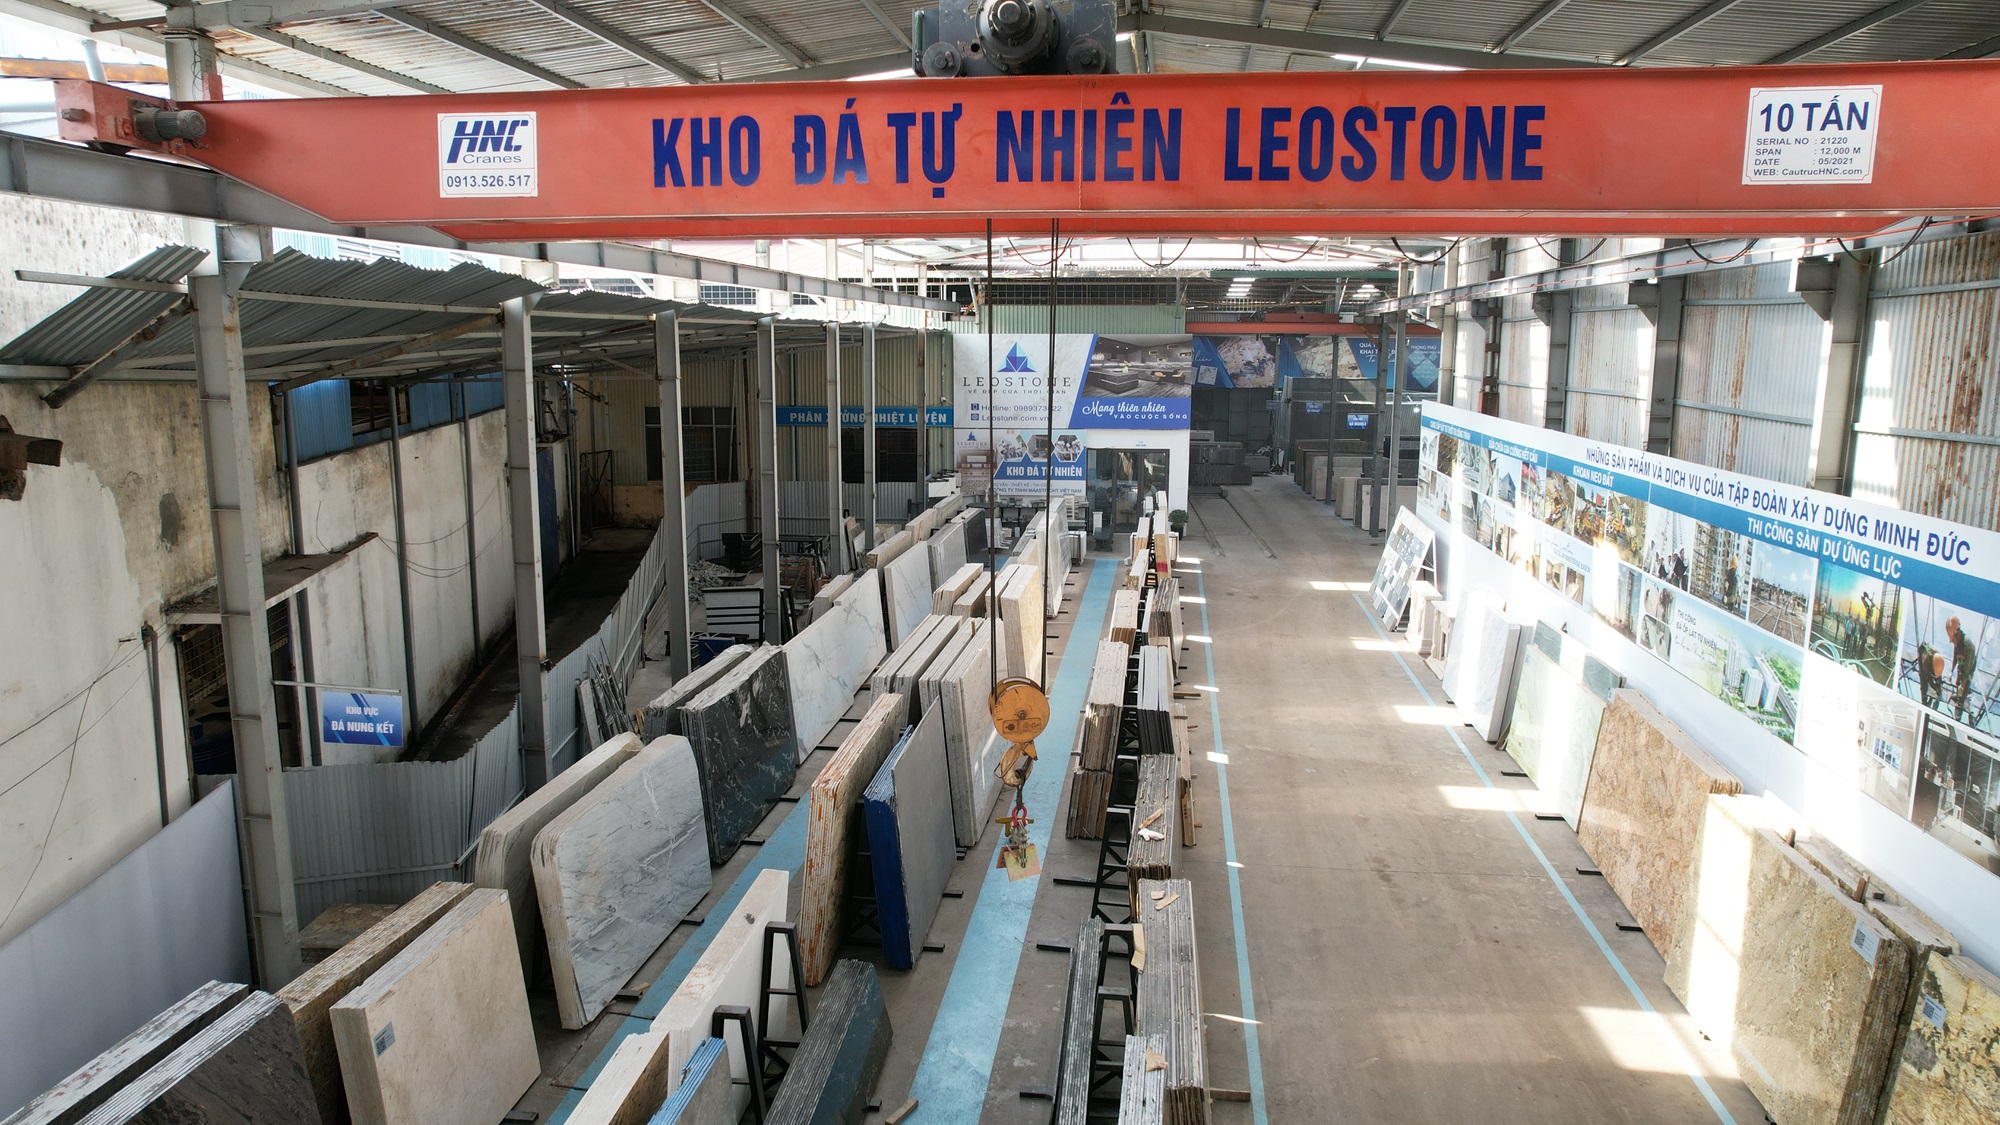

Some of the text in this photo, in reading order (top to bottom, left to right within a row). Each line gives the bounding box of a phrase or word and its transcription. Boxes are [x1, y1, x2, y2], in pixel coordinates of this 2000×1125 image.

[1760, 95, 1869, 132] 10 TẤN
[446, 119, 529, 163] HNC
[653, 92, 1546, 198] KHO ĐÁ TỰ NHIÊN LEOSTONE
[1794, 137, 1809, 145] NO
[1820, 147, 1850, 156] 12,000
[462, 154, 522, 164] Cranes
[1754, 158, 1780, 166] DATE
[1818, 157, 1853, 165] 05/2021
[1781, 167, 1863, 176] CautrucHNC.com
[446, 175, 530, 187] 0913.526.517
[1082, 400, 1167, 417] Mang thiên nhiên
[790, 411, 822, 423] PHÂN
[1007, 466, 1024, 476] KHO
[1027, 465, 1039, 476] ĐÁ
[1054, 464, 1082, 477] NHIÊN
[1573, 464, 1591, 480] KHOAN
[1590, 470, 1602, 484] NEO
[1585, 447, 1971, 566] NHỮNG SẢN PHẨM VÀ DỊCH VỤ CỦA TẬP ĐOÀN XÂY DỰNG MINH ĐỨC
[1747, 517, 1902, 579] THI CÔNG SÀN DỰ ỨNG LỰC
[346, 706, 379, 717] KHU VỰC
[331, 719, 394, 734] ĐÁ NUNG KẾT
